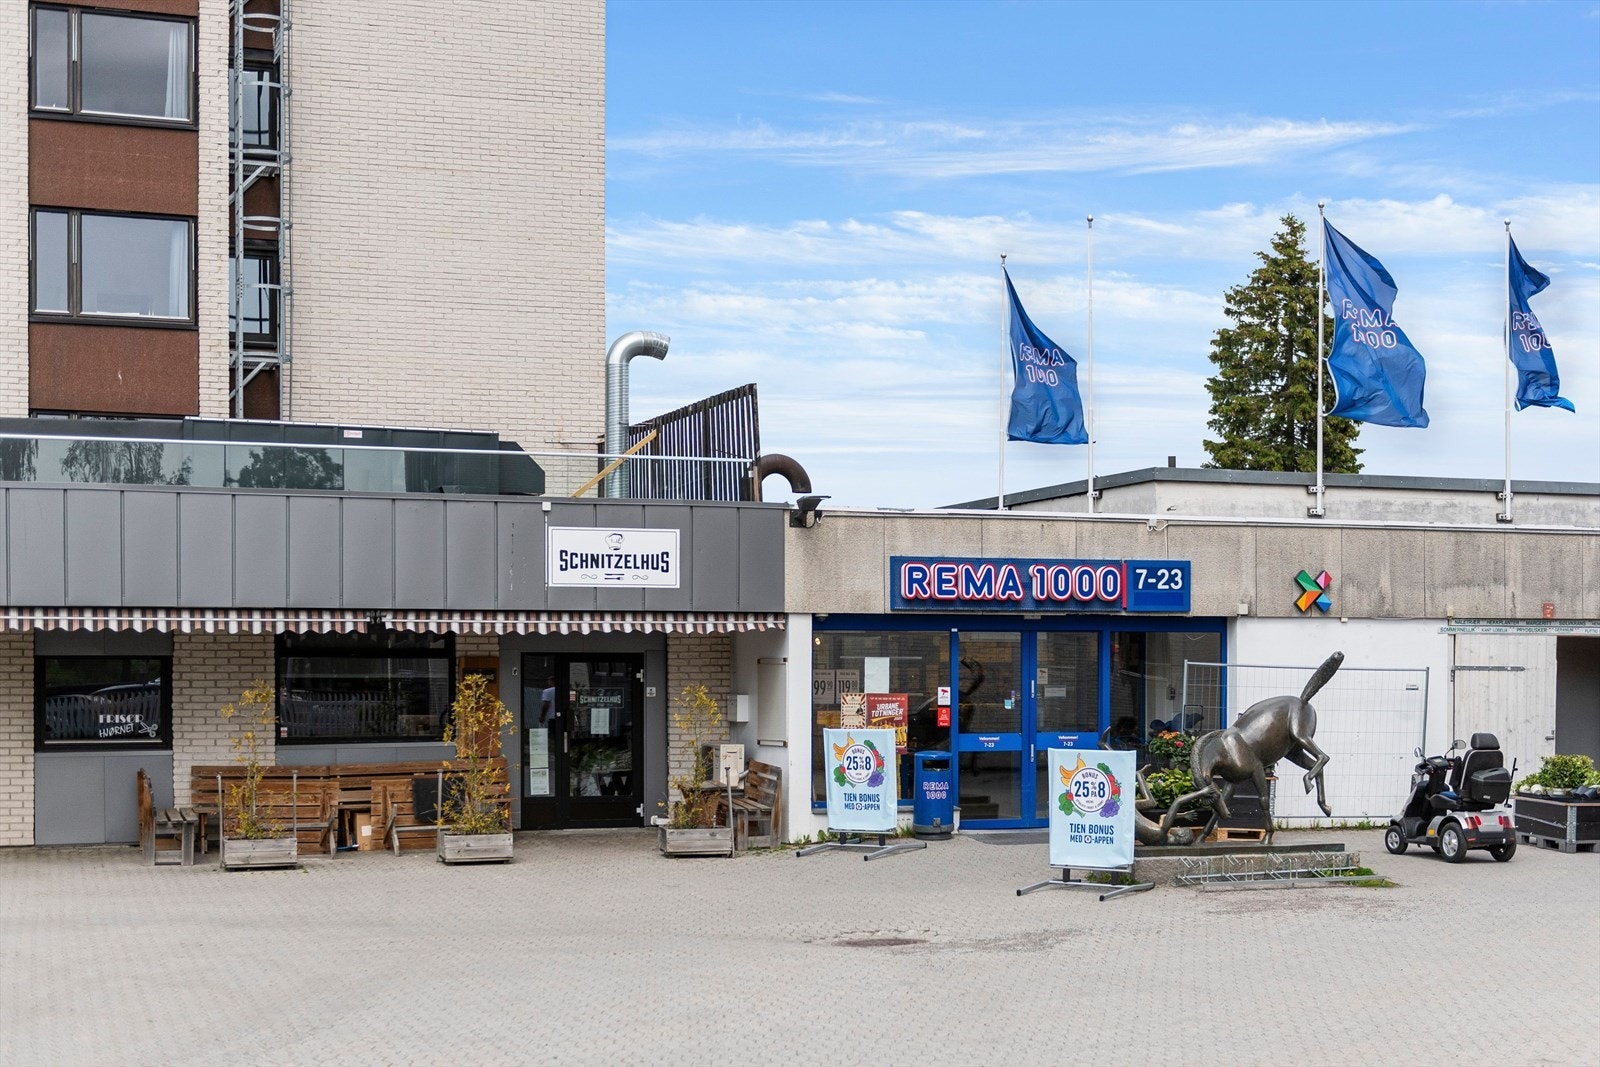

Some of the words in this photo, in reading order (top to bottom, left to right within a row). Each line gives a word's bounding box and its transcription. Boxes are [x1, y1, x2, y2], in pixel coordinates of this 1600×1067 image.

[559, 549, 670, 573] SCHNITZELHUS
[900, 562, 1024, 601] REMA
[1028, 563, 1120, 602] 1000
[1135, 568, 1183, 590] 7-23
[814, 680, 826, 695] 99
[838, 680, 851, 694] 119
[579, 695, 622, 704] SCHNITZELHUS
[846, 756, 858, 770] 25
[865, 756, 871, 770] 8
[923, 781, 949, 790] REMA
[1074, 780, 1089, 798] 25
[1098, 781, 1106, 798] 8
[844, 793, 857, 802] TJEN
[859, 793, 880, 803] BONUS
[926, 790, 947, 800] 1000
[1070, 823, 1086, 833] TJEN
[1088, 824, 1114, 835] BONUS
[1070, 834, 1082, 843] MED
